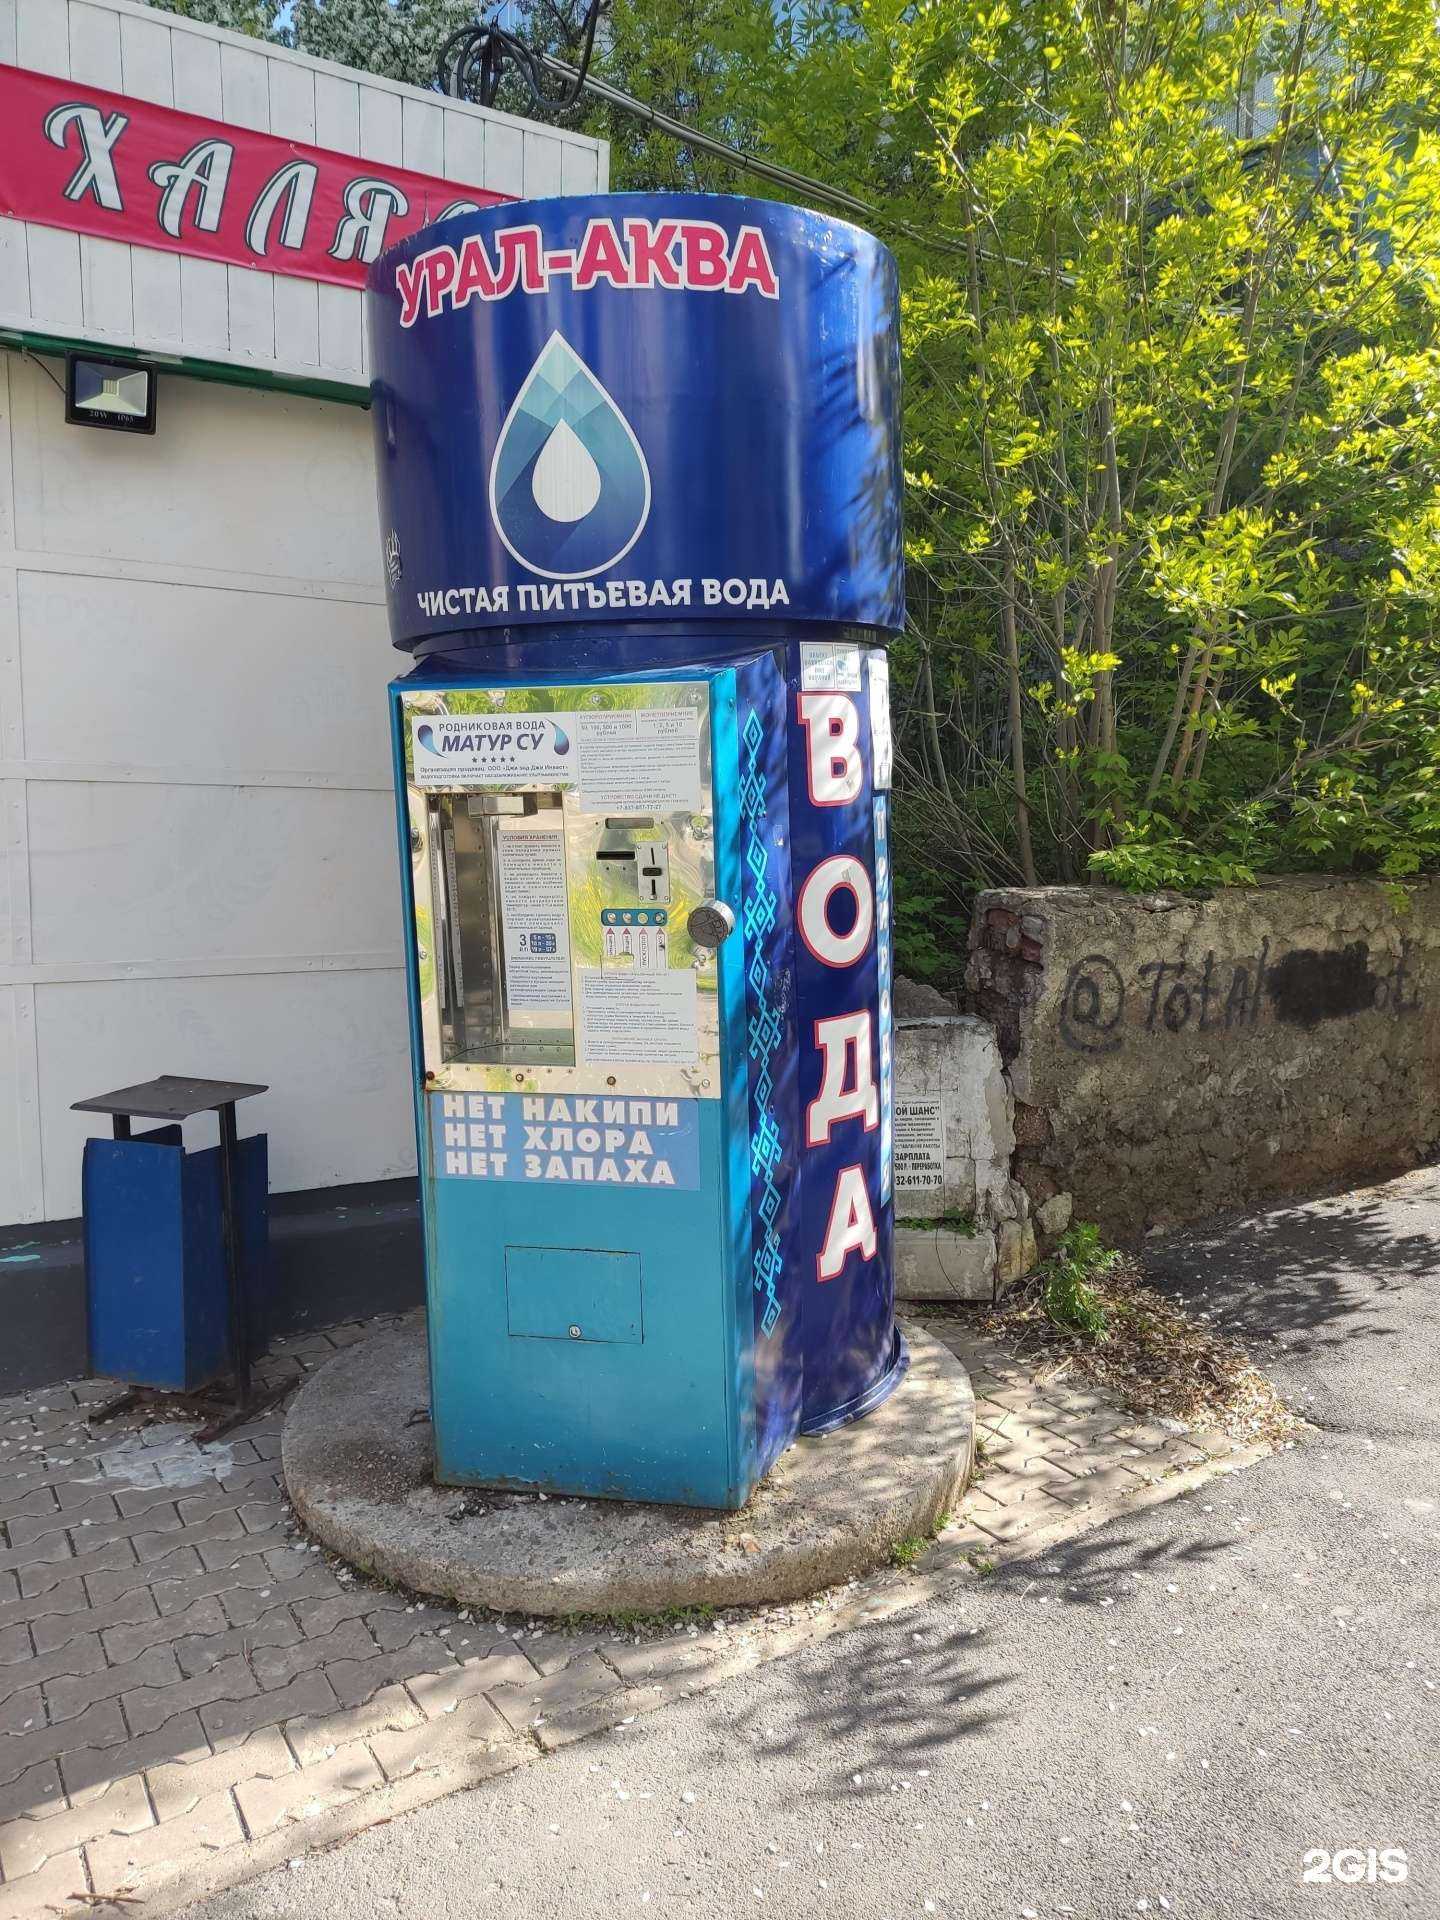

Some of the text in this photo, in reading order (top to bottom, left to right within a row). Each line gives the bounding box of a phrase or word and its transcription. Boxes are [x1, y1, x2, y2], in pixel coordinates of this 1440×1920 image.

[43, 103, 482, 263] ХАЛЯ
[396, 218, 779, 329] УРАЛ-АКВА
[417, 578, 790, 617] ЧИСТАЯ ПИТЬЕВАЯ ВОДА
[439, 720, 546, 732] РОДНИКОВАЯ ВОДА
[442, 733, 544, 752] МАТУР СУ
[520, 934, 526, 946] 3
[443, 1094, 678, 1126] НЕТ НАКИПИ
[444, 1123, 653, 1155] НЕТ ХЛОРА
[446, 1151, 676, 1185] НЕТ ЗАПАХА
[895, 1153, 931, 1161] ЗАРПЛАТА
